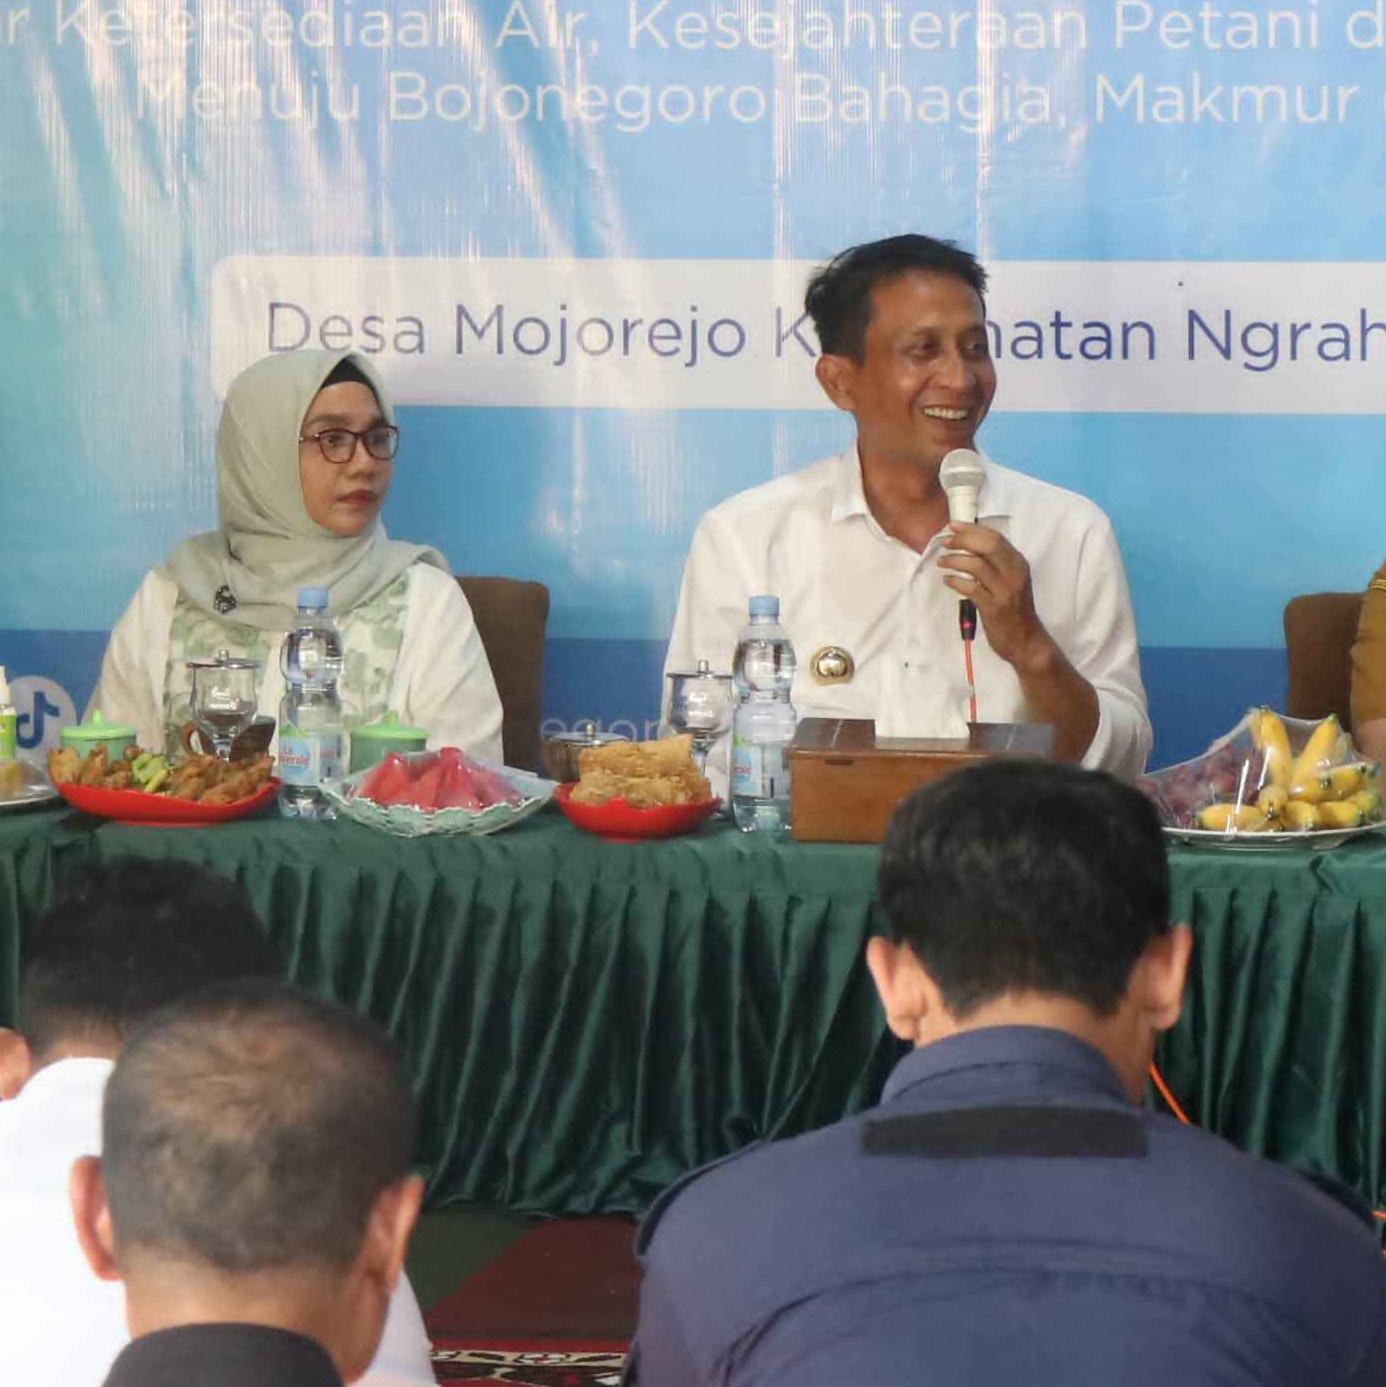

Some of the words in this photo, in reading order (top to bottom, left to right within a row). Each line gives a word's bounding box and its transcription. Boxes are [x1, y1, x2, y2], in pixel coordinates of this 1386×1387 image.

[138, 70, 361, 130] Menuju
[388, 71, 767, 133] Bojonegoro
[794, 70, 1067, 133] Bahagia,
[1095, 71, 1358, 123] Makmur
[268, 302, 425, 354] Desa
[454, 303, 746, 367] Mojorejo
